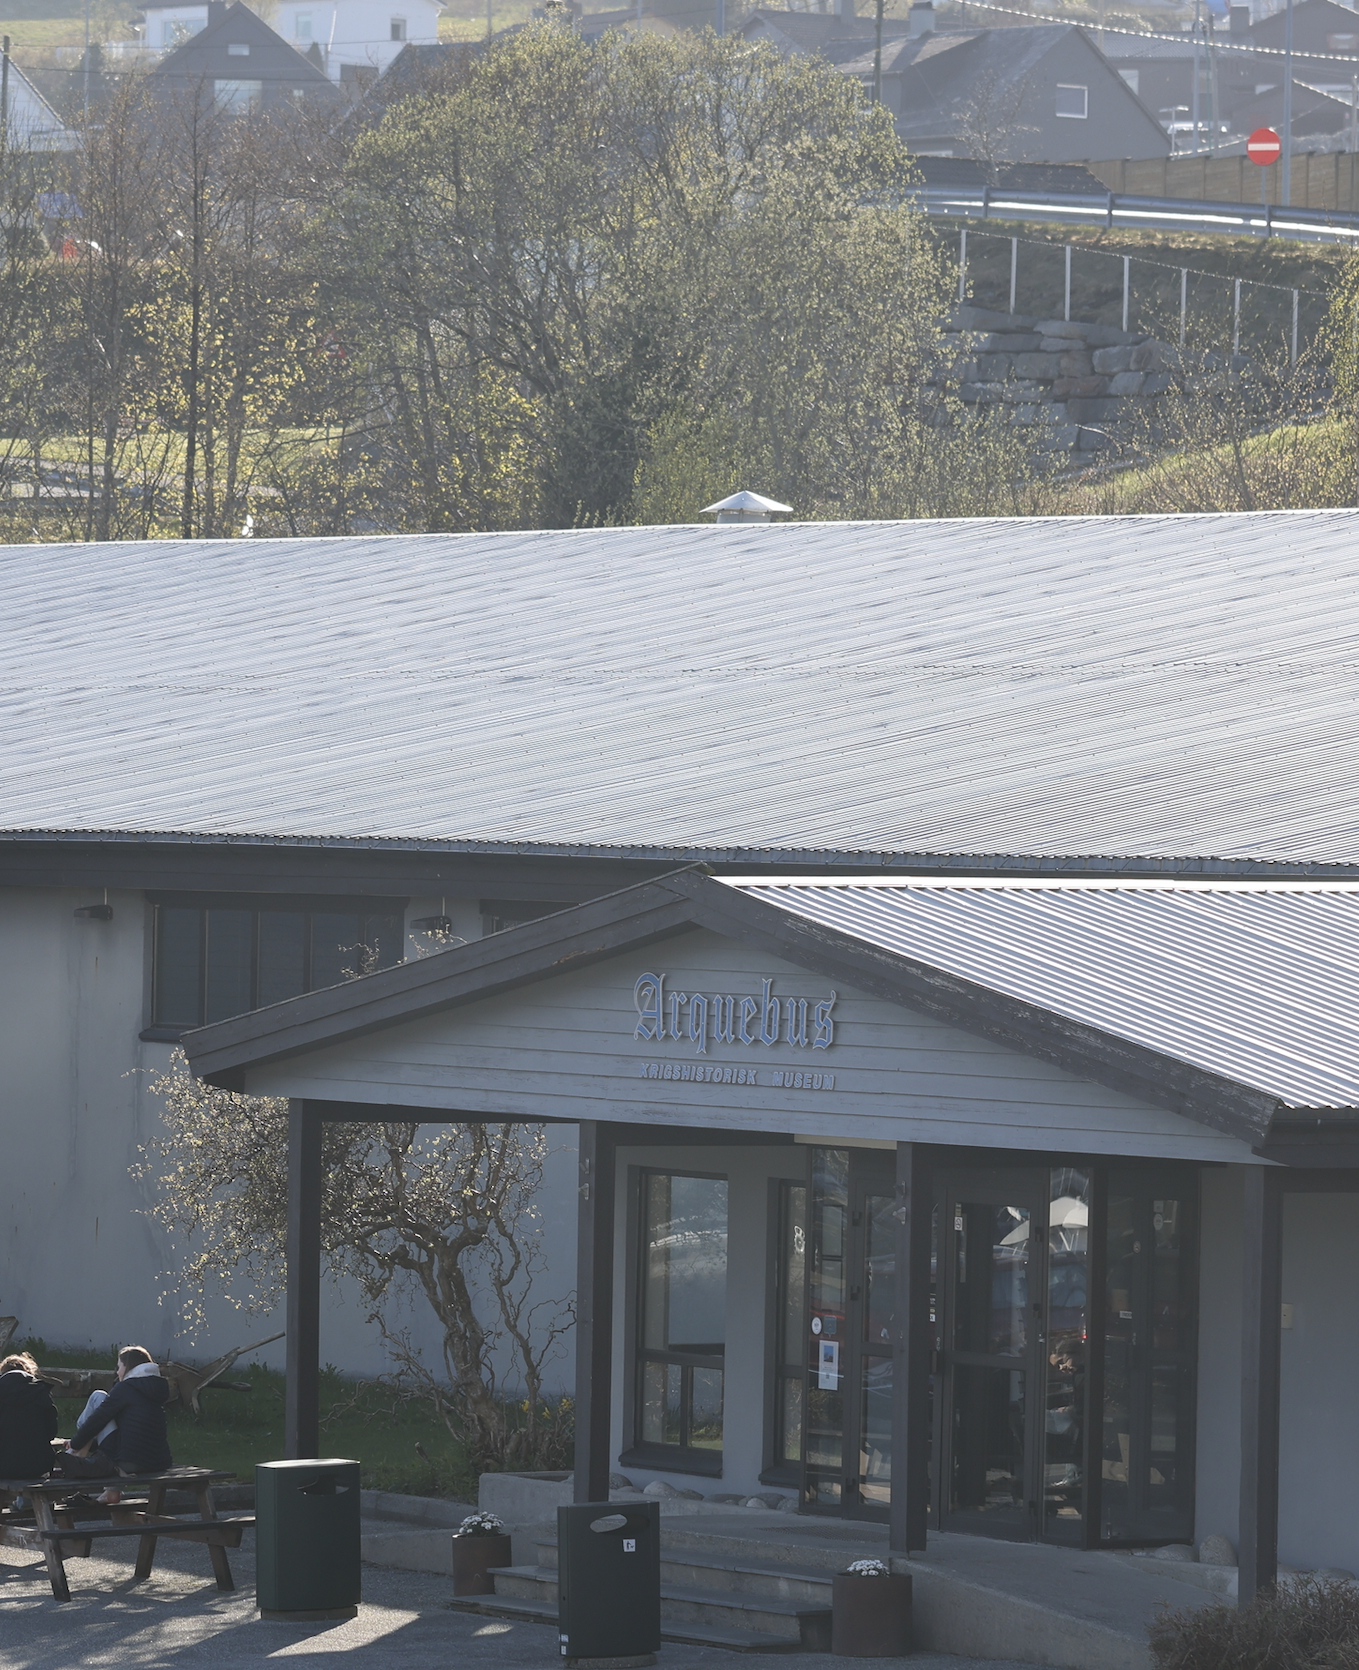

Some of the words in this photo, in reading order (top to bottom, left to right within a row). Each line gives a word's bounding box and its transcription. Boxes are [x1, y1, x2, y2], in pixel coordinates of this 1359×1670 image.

[634, 972, 837, 1054] Arquebus
[640, 1063, 758, 1085] KRIGSHISTORISK
[772, 1071, 835, 1090] MUSEUM
